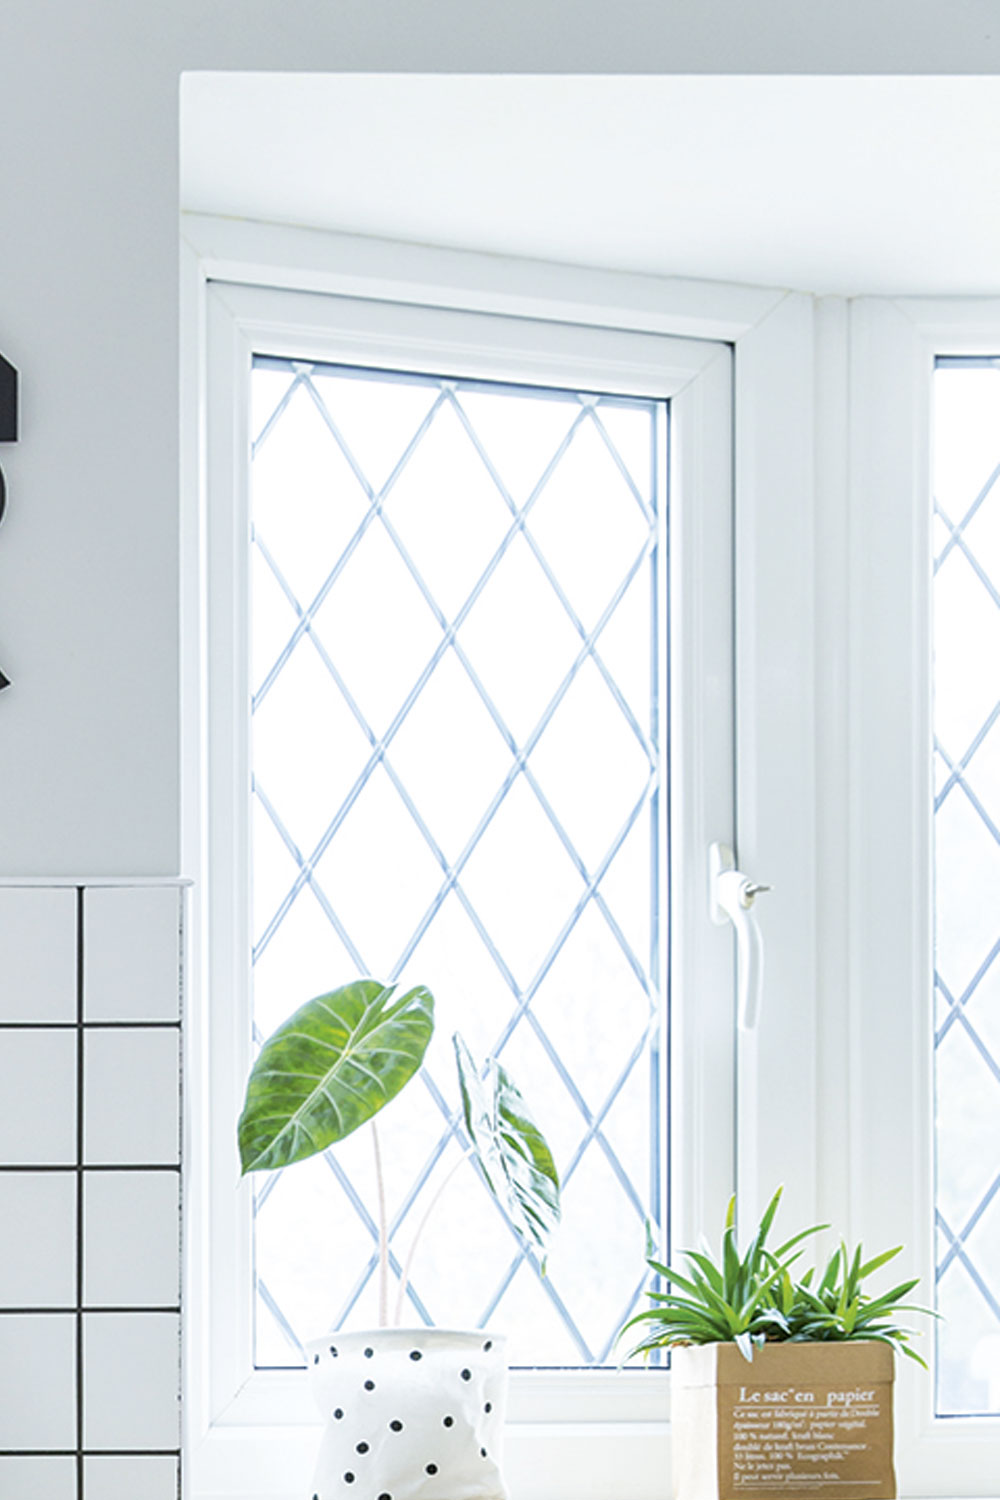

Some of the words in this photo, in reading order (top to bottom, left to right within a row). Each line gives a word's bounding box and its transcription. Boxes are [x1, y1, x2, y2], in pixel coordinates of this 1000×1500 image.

[739, 1386, 761, 1402] Le
[794, 1391, 814, 1402] en
[826, 1387, 876, 1407] papier
